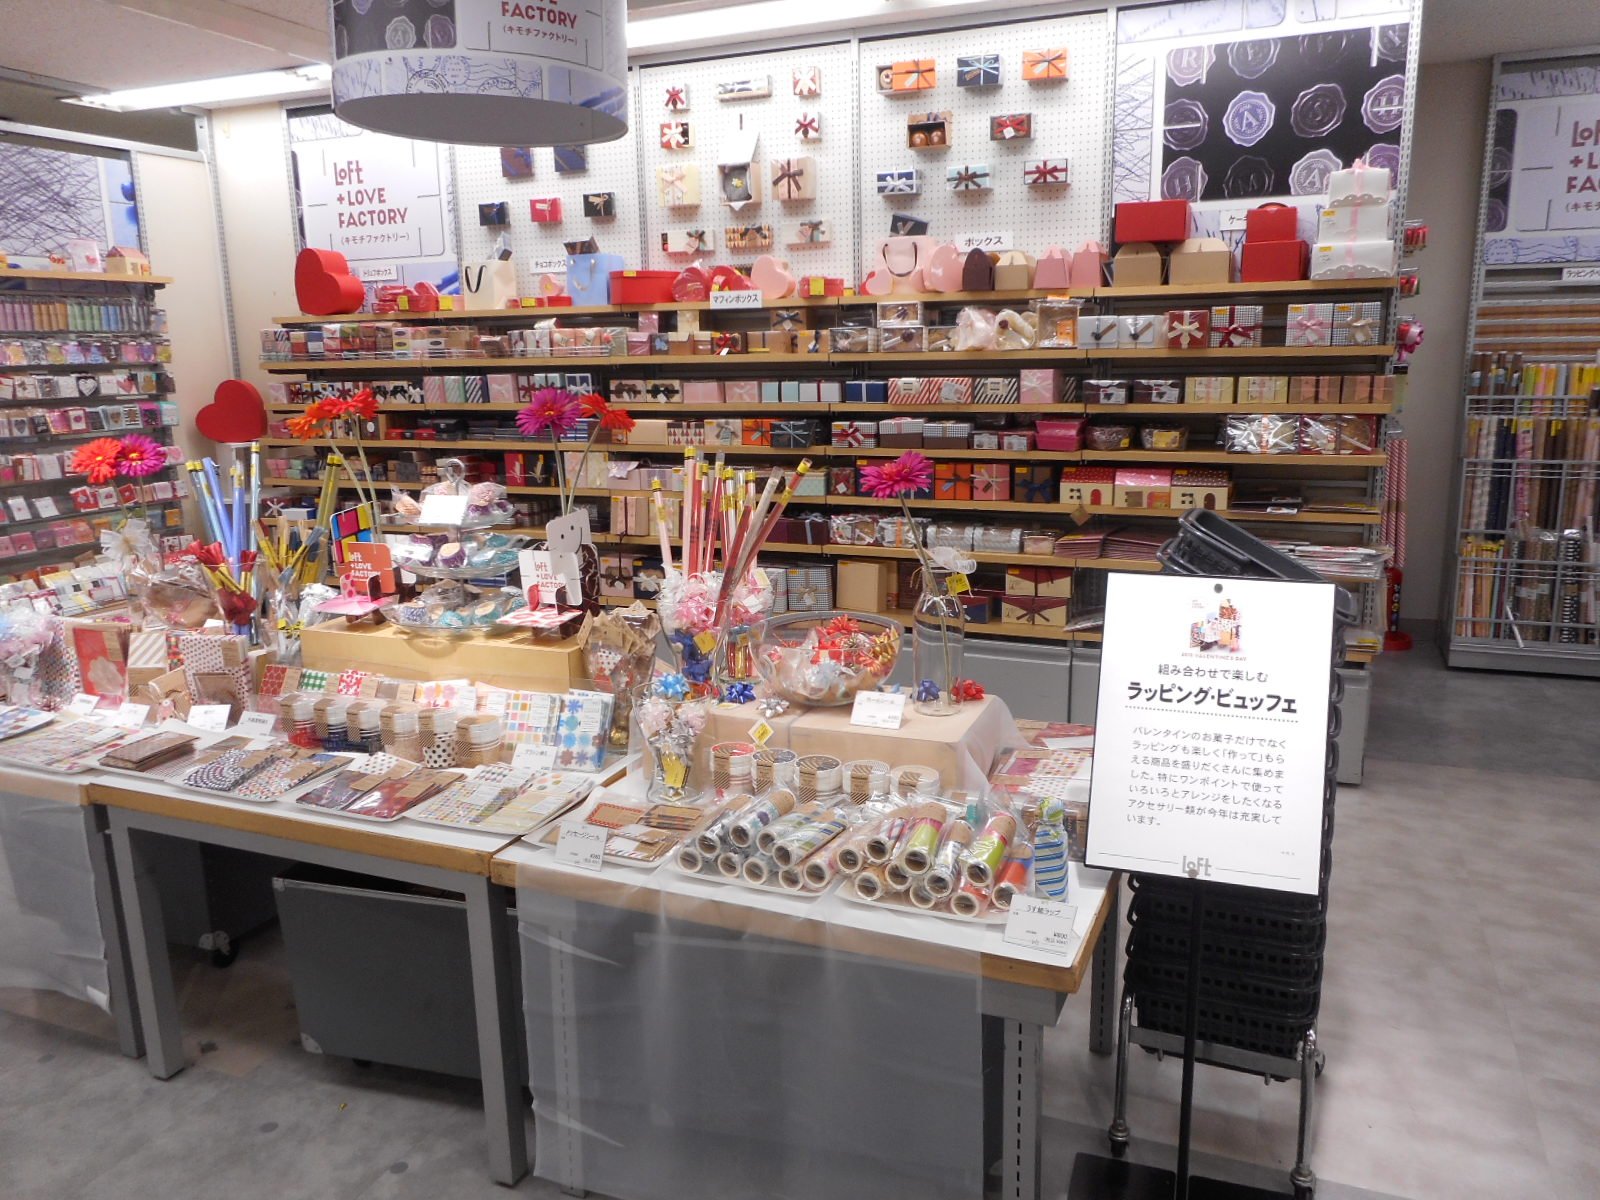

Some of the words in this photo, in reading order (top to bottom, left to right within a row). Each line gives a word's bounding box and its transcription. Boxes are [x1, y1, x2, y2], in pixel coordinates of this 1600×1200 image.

[501, 1, 577, 29] FACTORY
[338, 207, 408, 229] FACTORY
[713, 294, 758, 304] マフィンボックス
[1158, 663, 1268, 683] 組み合わせで楽しむ
[1128, 682, 1297, 714] ラッピング・ビュッフェ
[1133, 727, 1286, 749] バレンタインのお菓子だけでなく
[1131, 755, 1284, 779] える商品を盛りだくさんに集めま
[1129, 785, 1282, 809] いろいろとアレンジをしたくなる
[1128, 799, 1281, 825] アクセサリー類が今年は充実して
